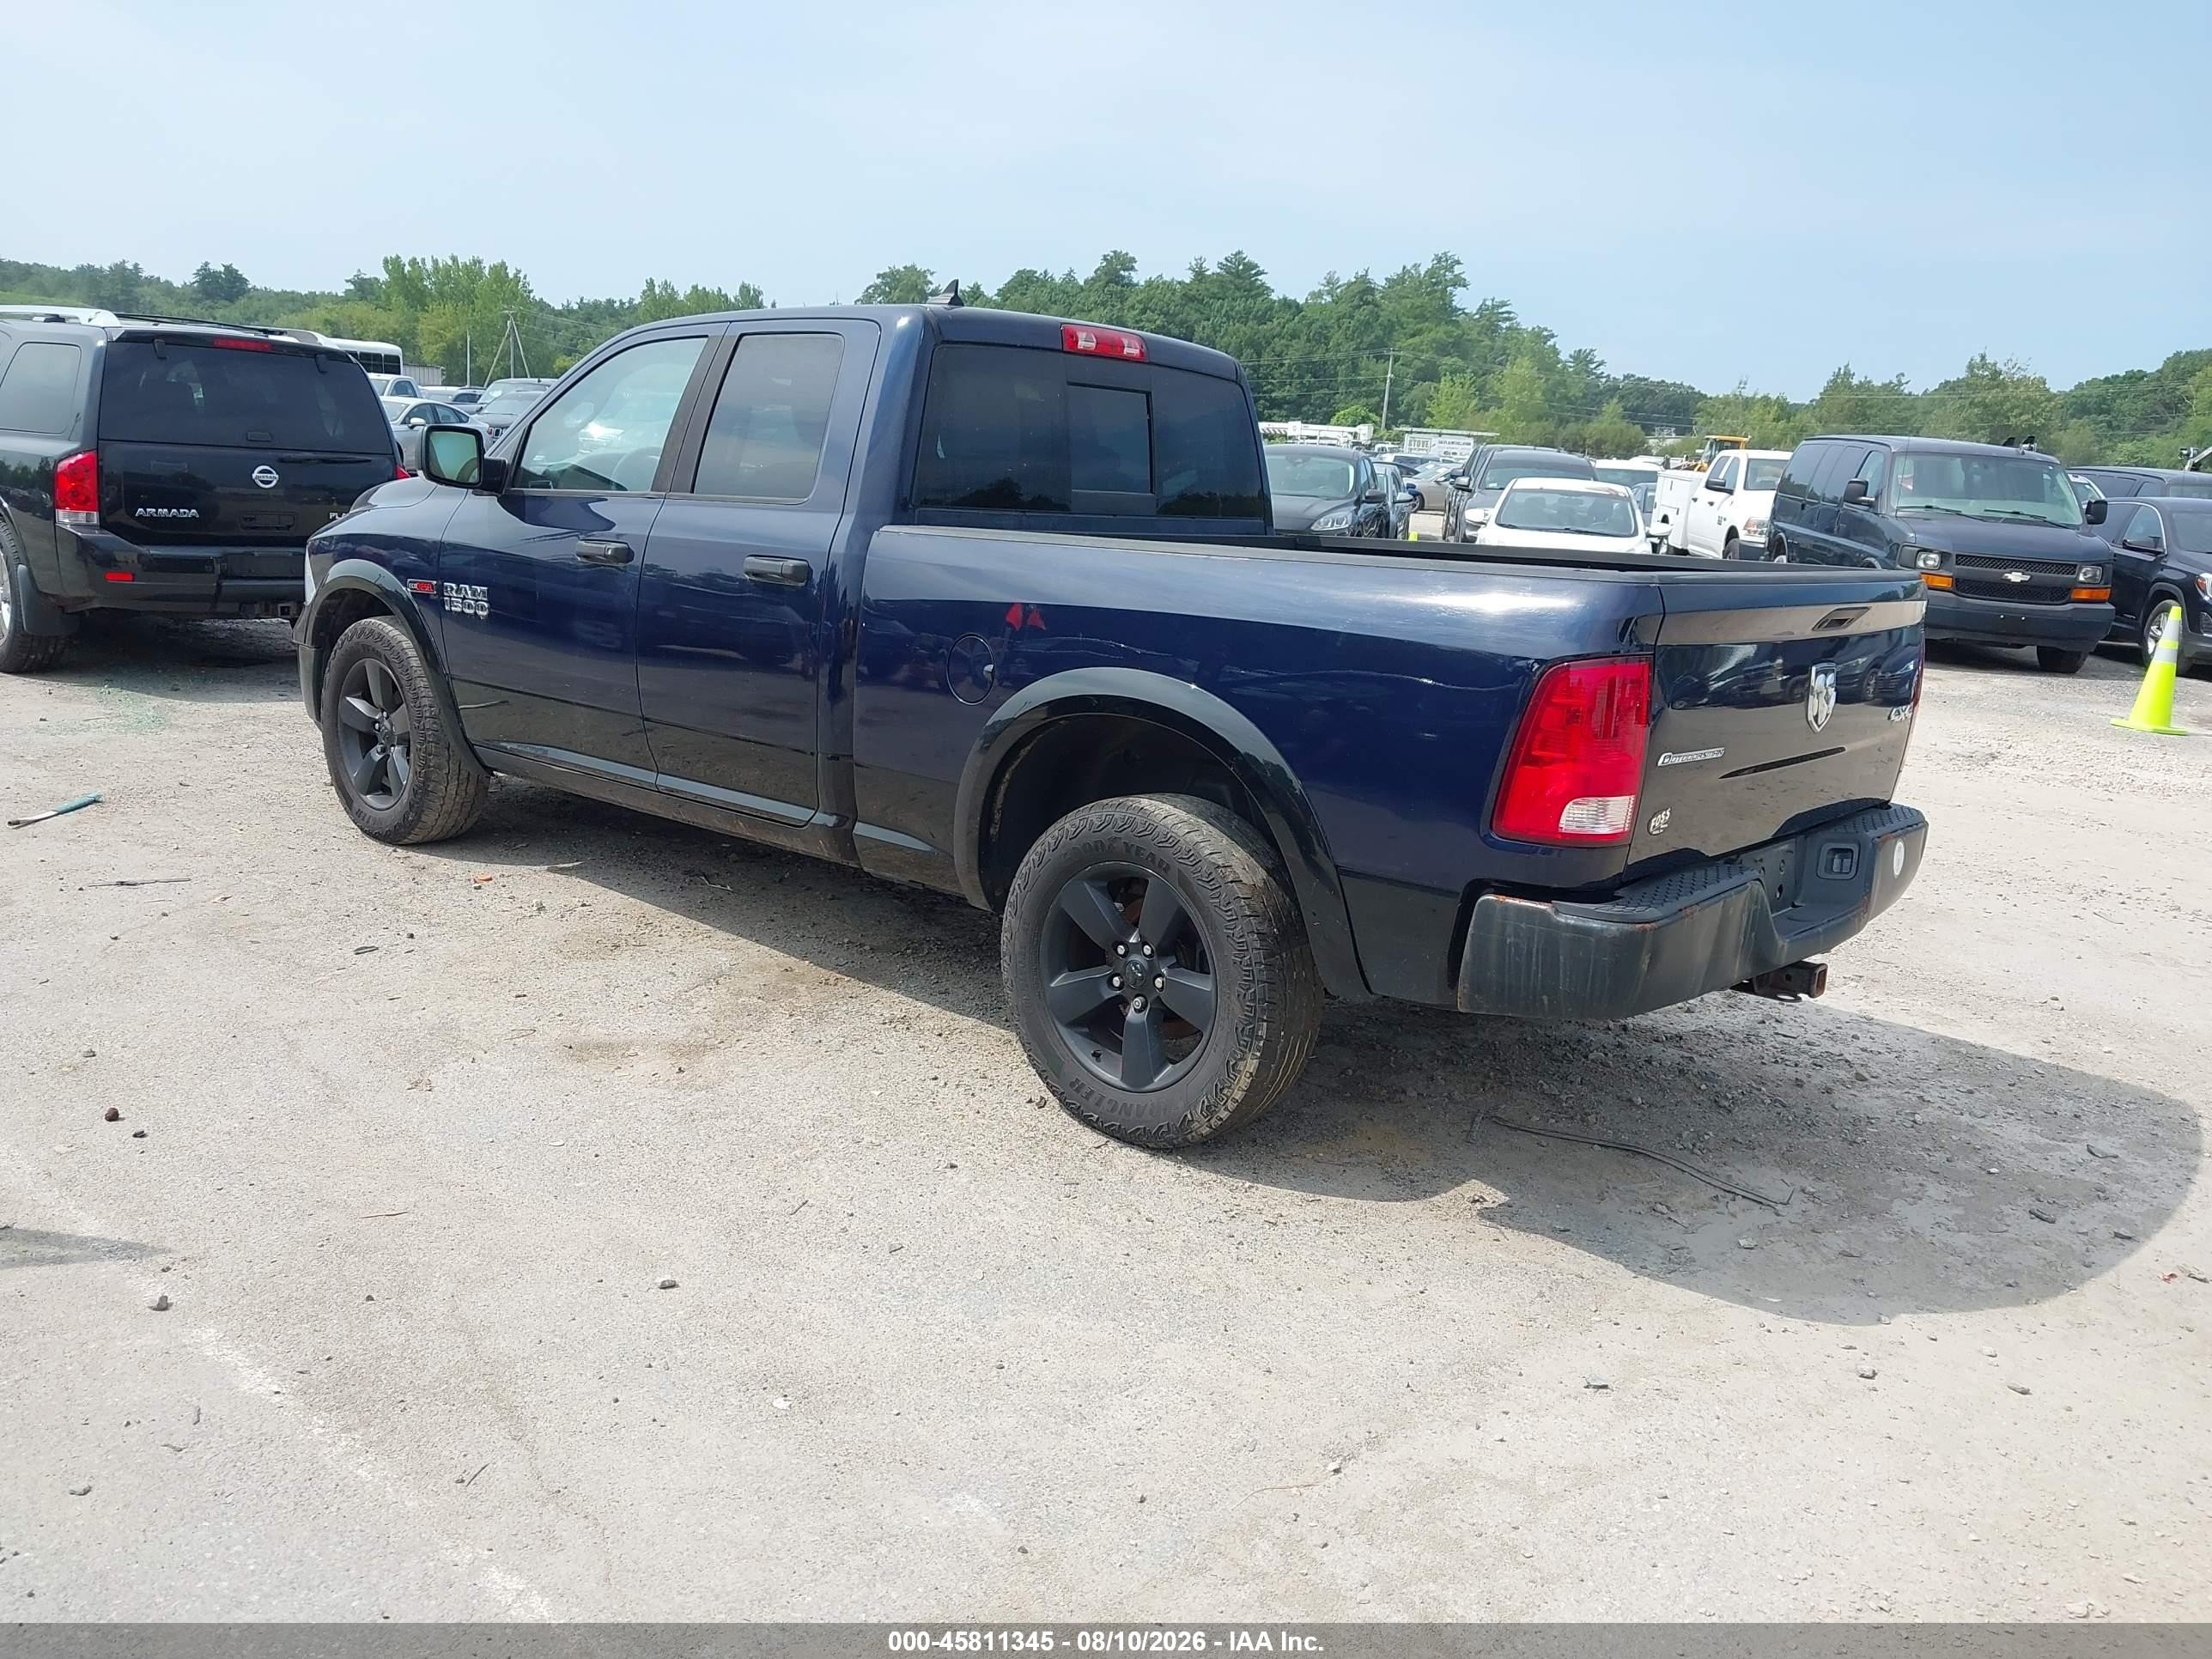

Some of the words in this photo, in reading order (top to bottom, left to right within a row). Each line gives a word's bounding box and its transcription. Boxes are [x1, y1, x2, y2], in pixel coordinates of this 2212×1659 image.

[135, 507, 200, 518] ARMADA
[443, 582, 488, 601] RAM
[443, 597, 489, 617] 1500
[1649, 806, 1671, 832] FOSS
